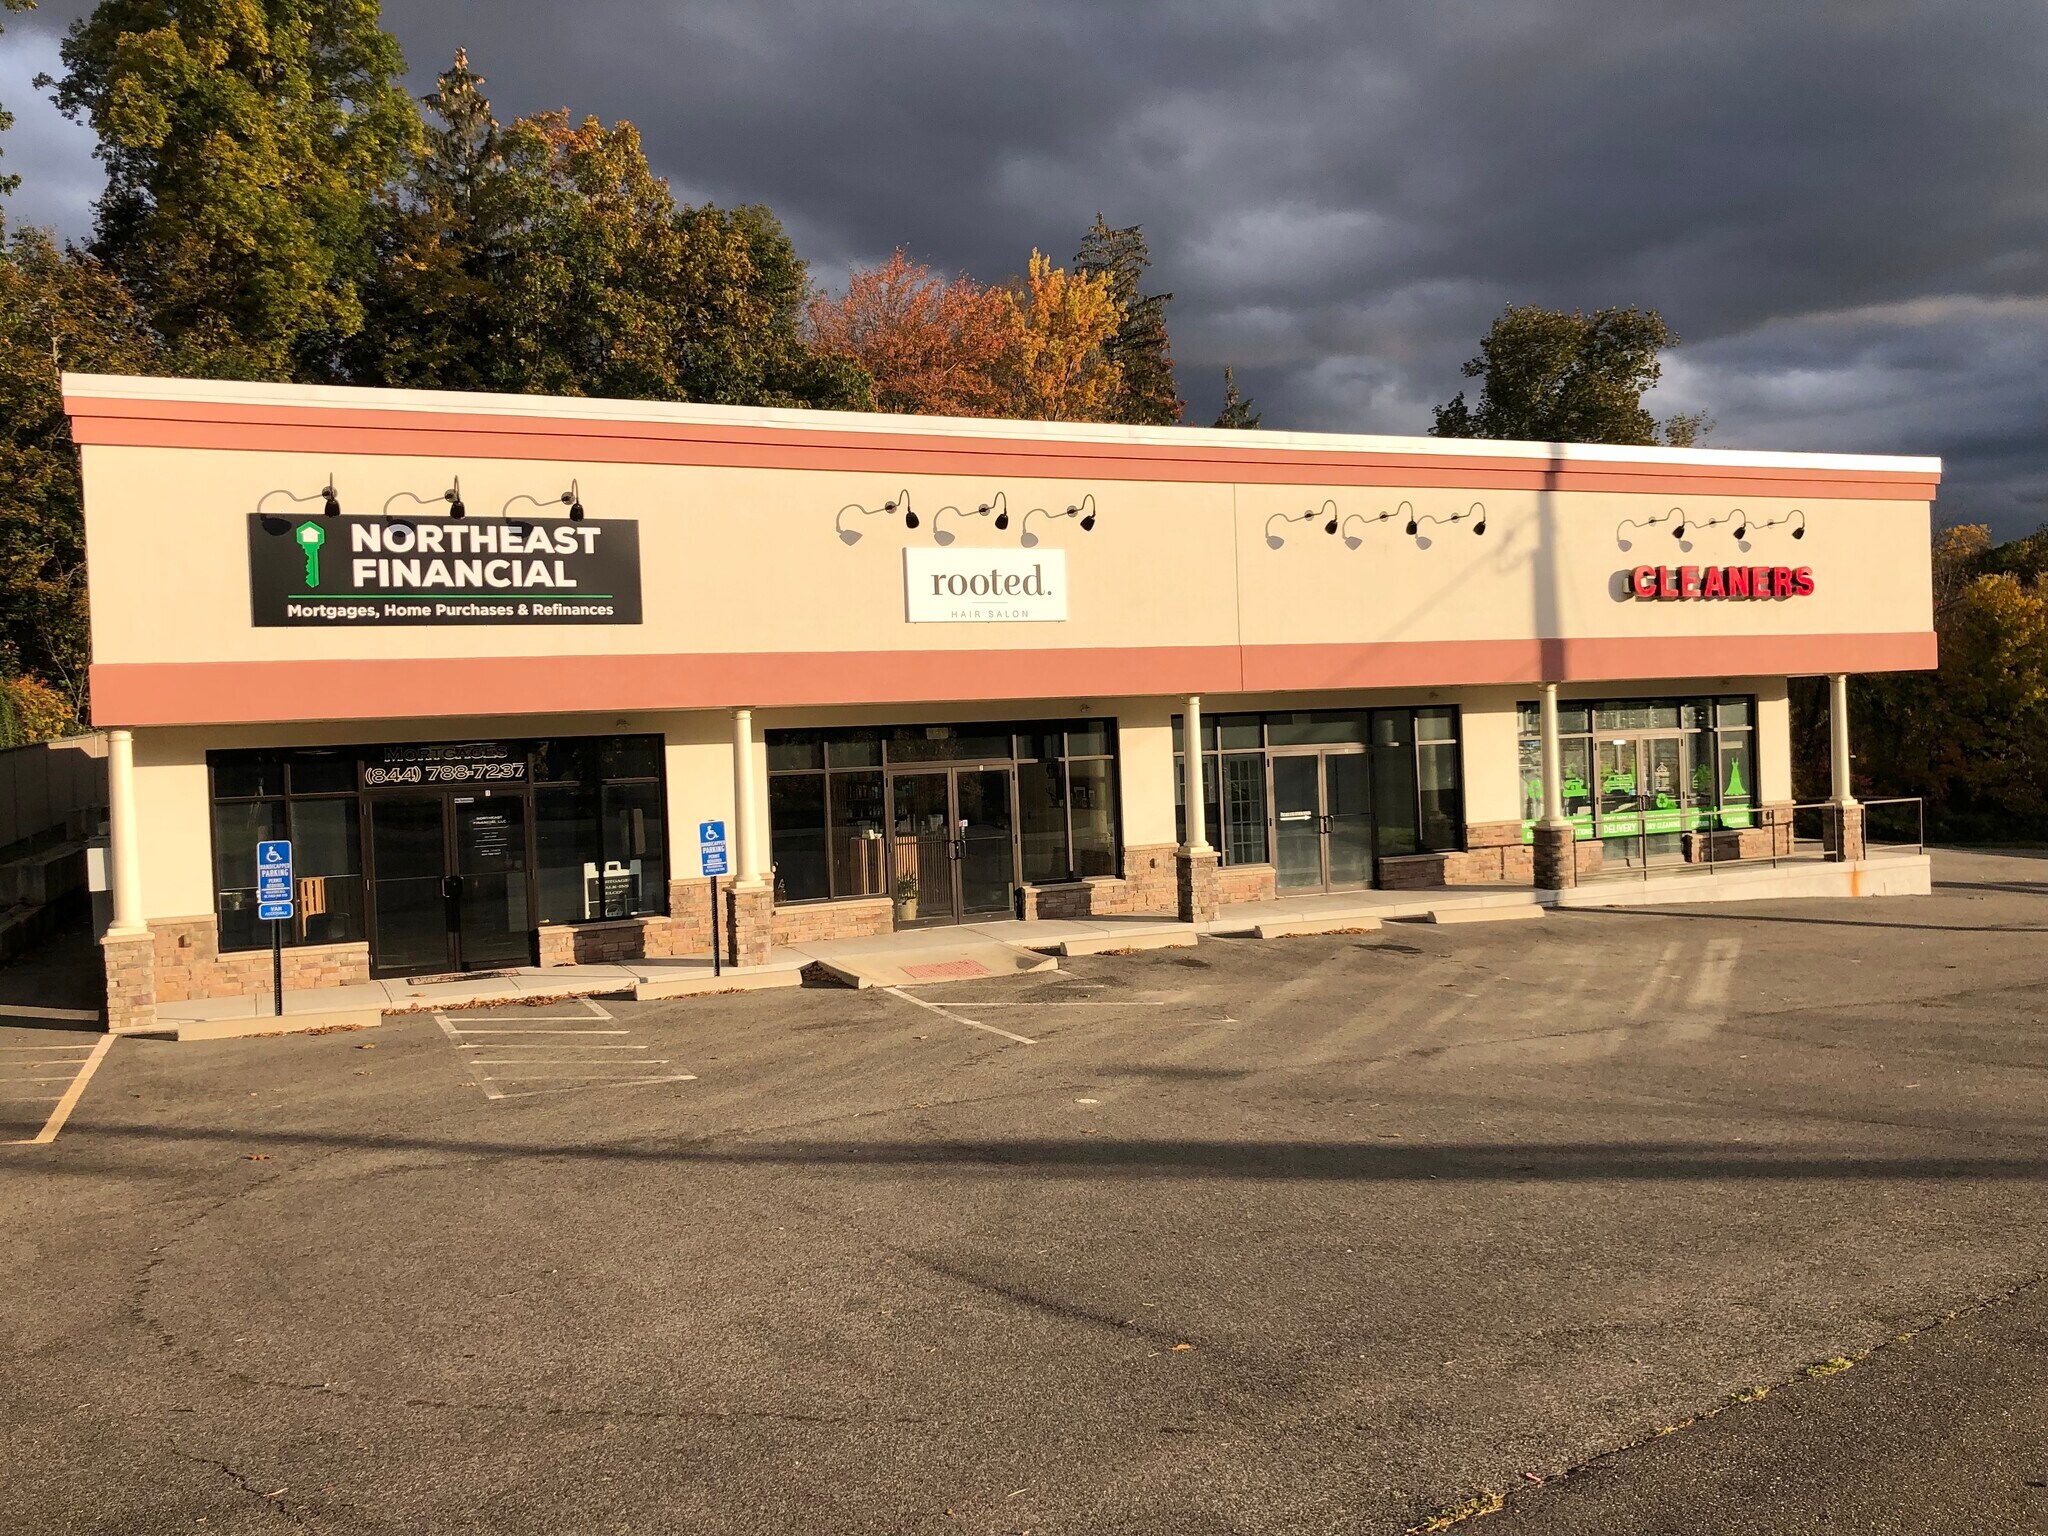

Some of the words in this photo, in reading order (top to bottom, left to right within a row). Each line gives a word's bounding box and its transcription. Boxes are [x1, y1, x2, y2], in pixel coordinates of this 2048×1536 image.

[351, 524, 601, 554] NORTHEAST
[353, 558, 577, 588] FINANCIAL
[931, 564, 1052, 596] rooted.
[1633, 565, 1815, 598] CLEANERS
[287, 603, 380, 619] Mortgages,
[384, 603, 432, 616] Home
[435, 603, 514, 617] Purchases
[517, 603, 529, 616] &
[532, 603, 614, 616] Refinances
[988, 610, 1029, 618] SALON
[365, 765, 422, 785] (844)
[425, 762, 525, 781] 788-7237
[1603, 823, 1637, 834] DELIVERY
[261, 869, 289, 877] PARKING
